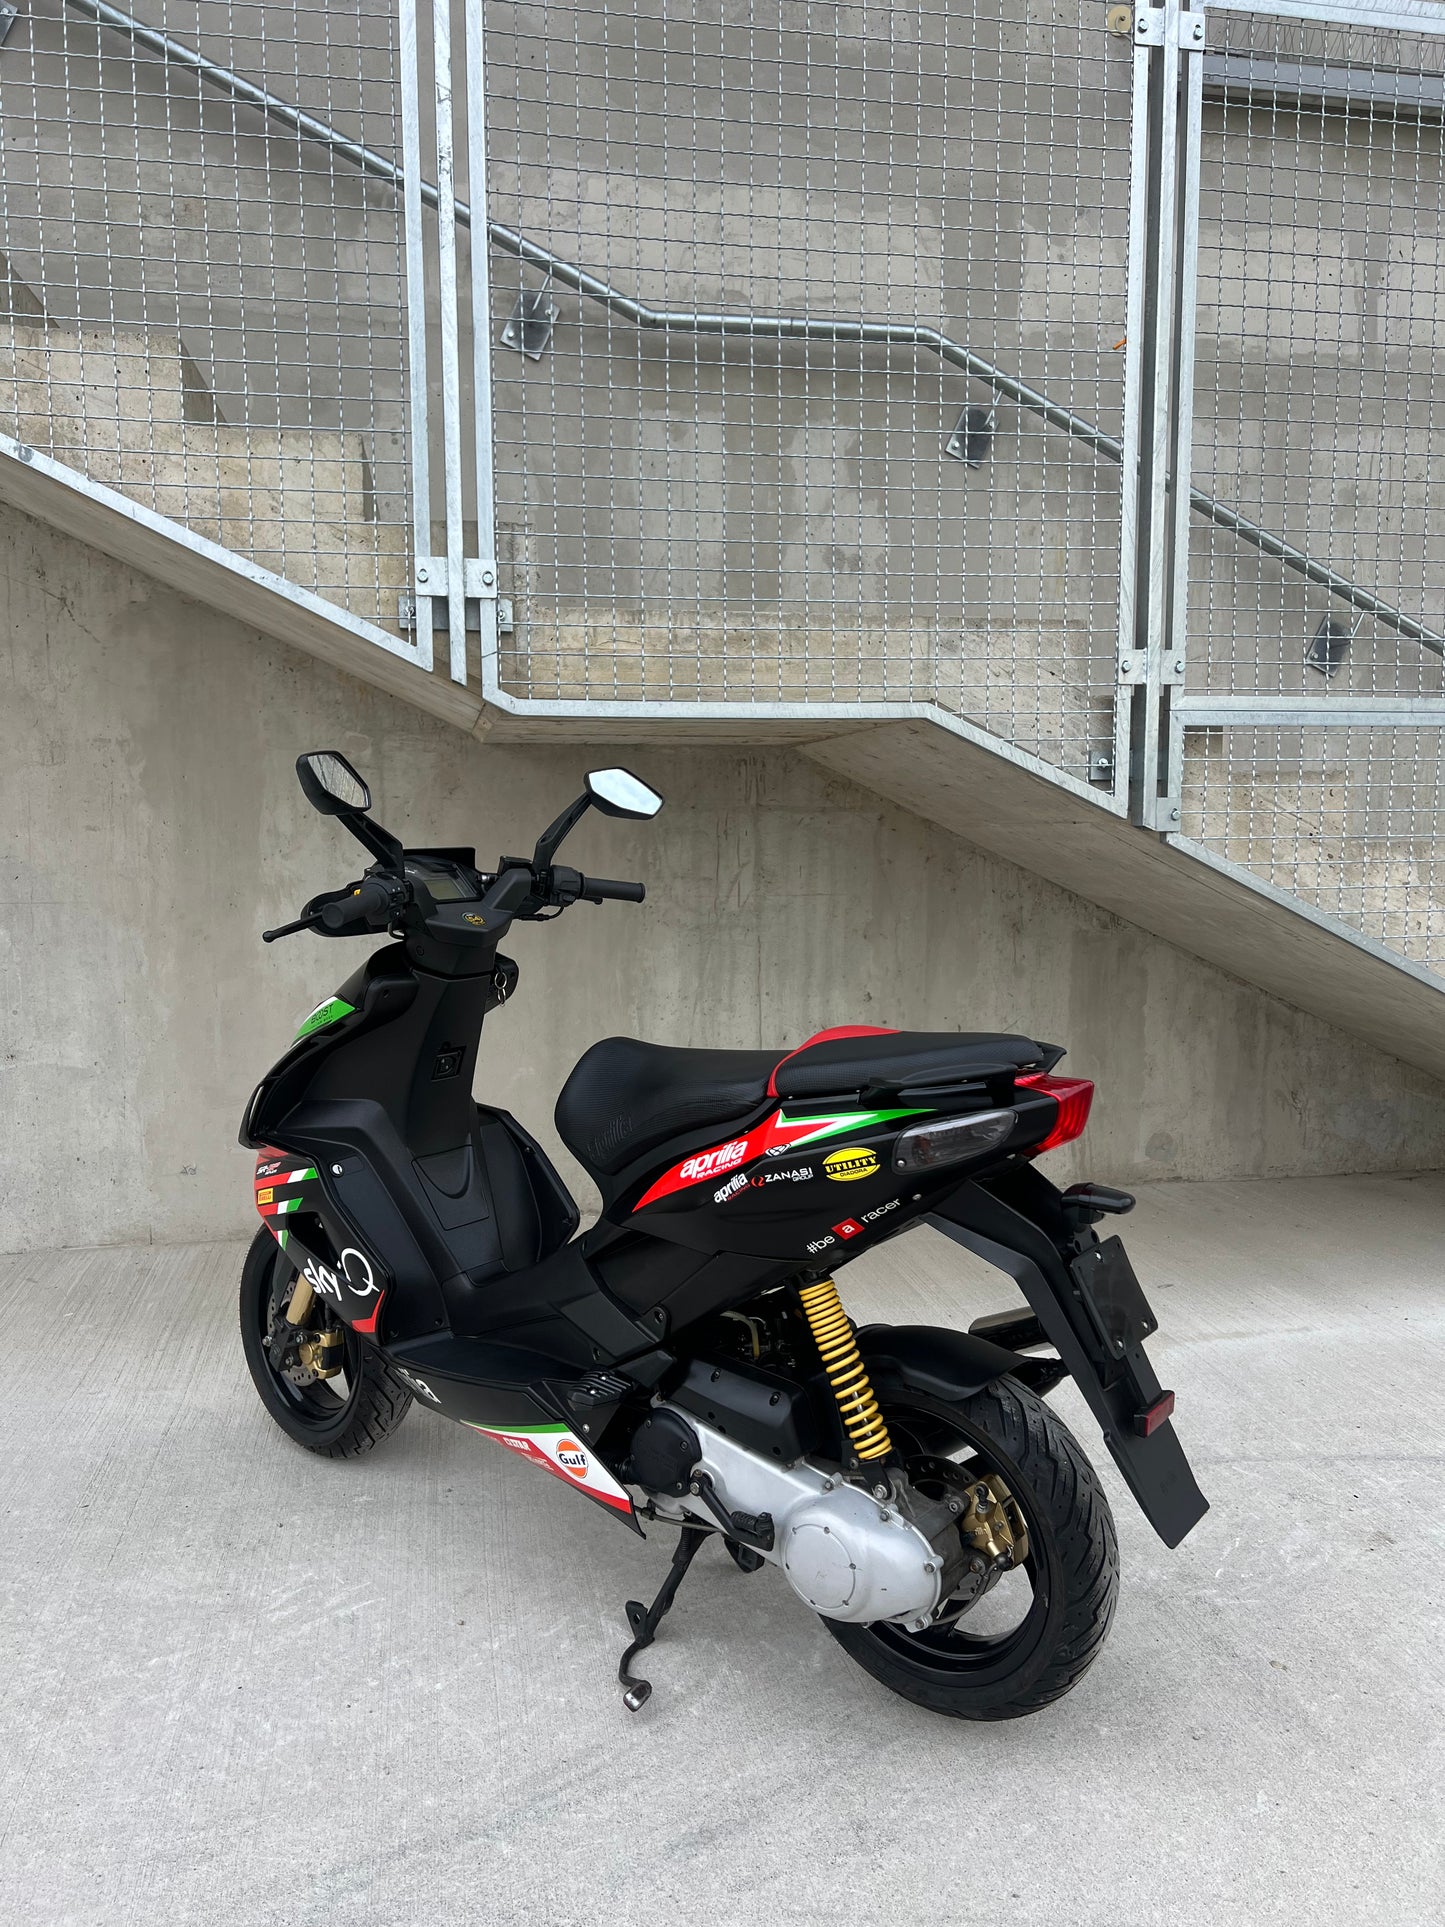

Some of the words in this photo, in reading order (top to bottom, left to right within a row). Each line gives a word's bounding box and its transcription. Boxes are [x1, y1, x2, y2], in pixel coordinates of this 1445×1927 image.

[680, 1140, 748, 1179] aprilia
[696, 1157, 742, 1179] RACING
[825, 1156, 877, 1174] UTILITY
[765, 1167, 813, 1183] ZANASI
[839, 1168, 868, 1177] DIADORA
[713, 1173, 748, 1203] aprilia
[806, 1235, 836, 1254] #be
[841, 1224, 855, 1234] a
[860, 1198, 901, 1223] racer
[303, 1257, 342, 1301] sky
[341, 1247, 380, 1297] Q
[559, 1453, 586, 1466] Gulf
